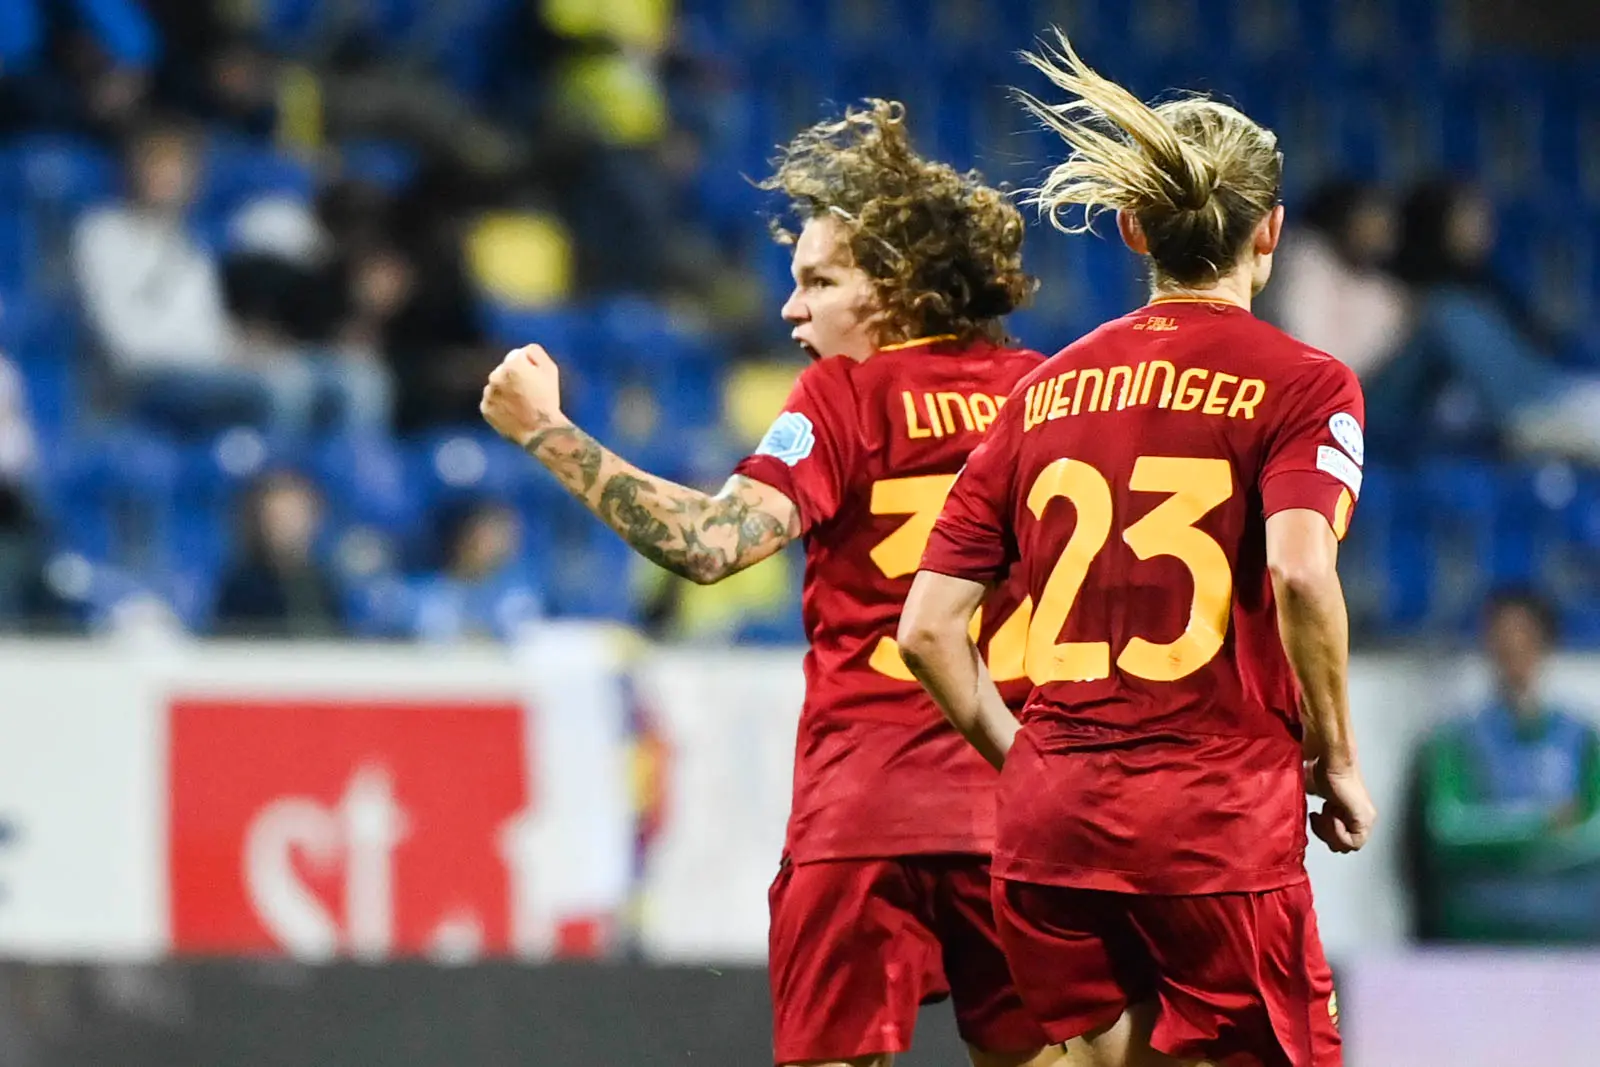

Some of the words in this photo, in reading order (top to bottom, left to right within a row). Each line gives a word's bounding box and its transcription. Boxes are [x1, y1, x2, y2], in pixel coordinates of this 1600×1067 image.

[902, 390, 1008, 439] LINA
[1023, 360, 1266, 433] WENNINGER
[1024, 455, 1233, 686] 23
